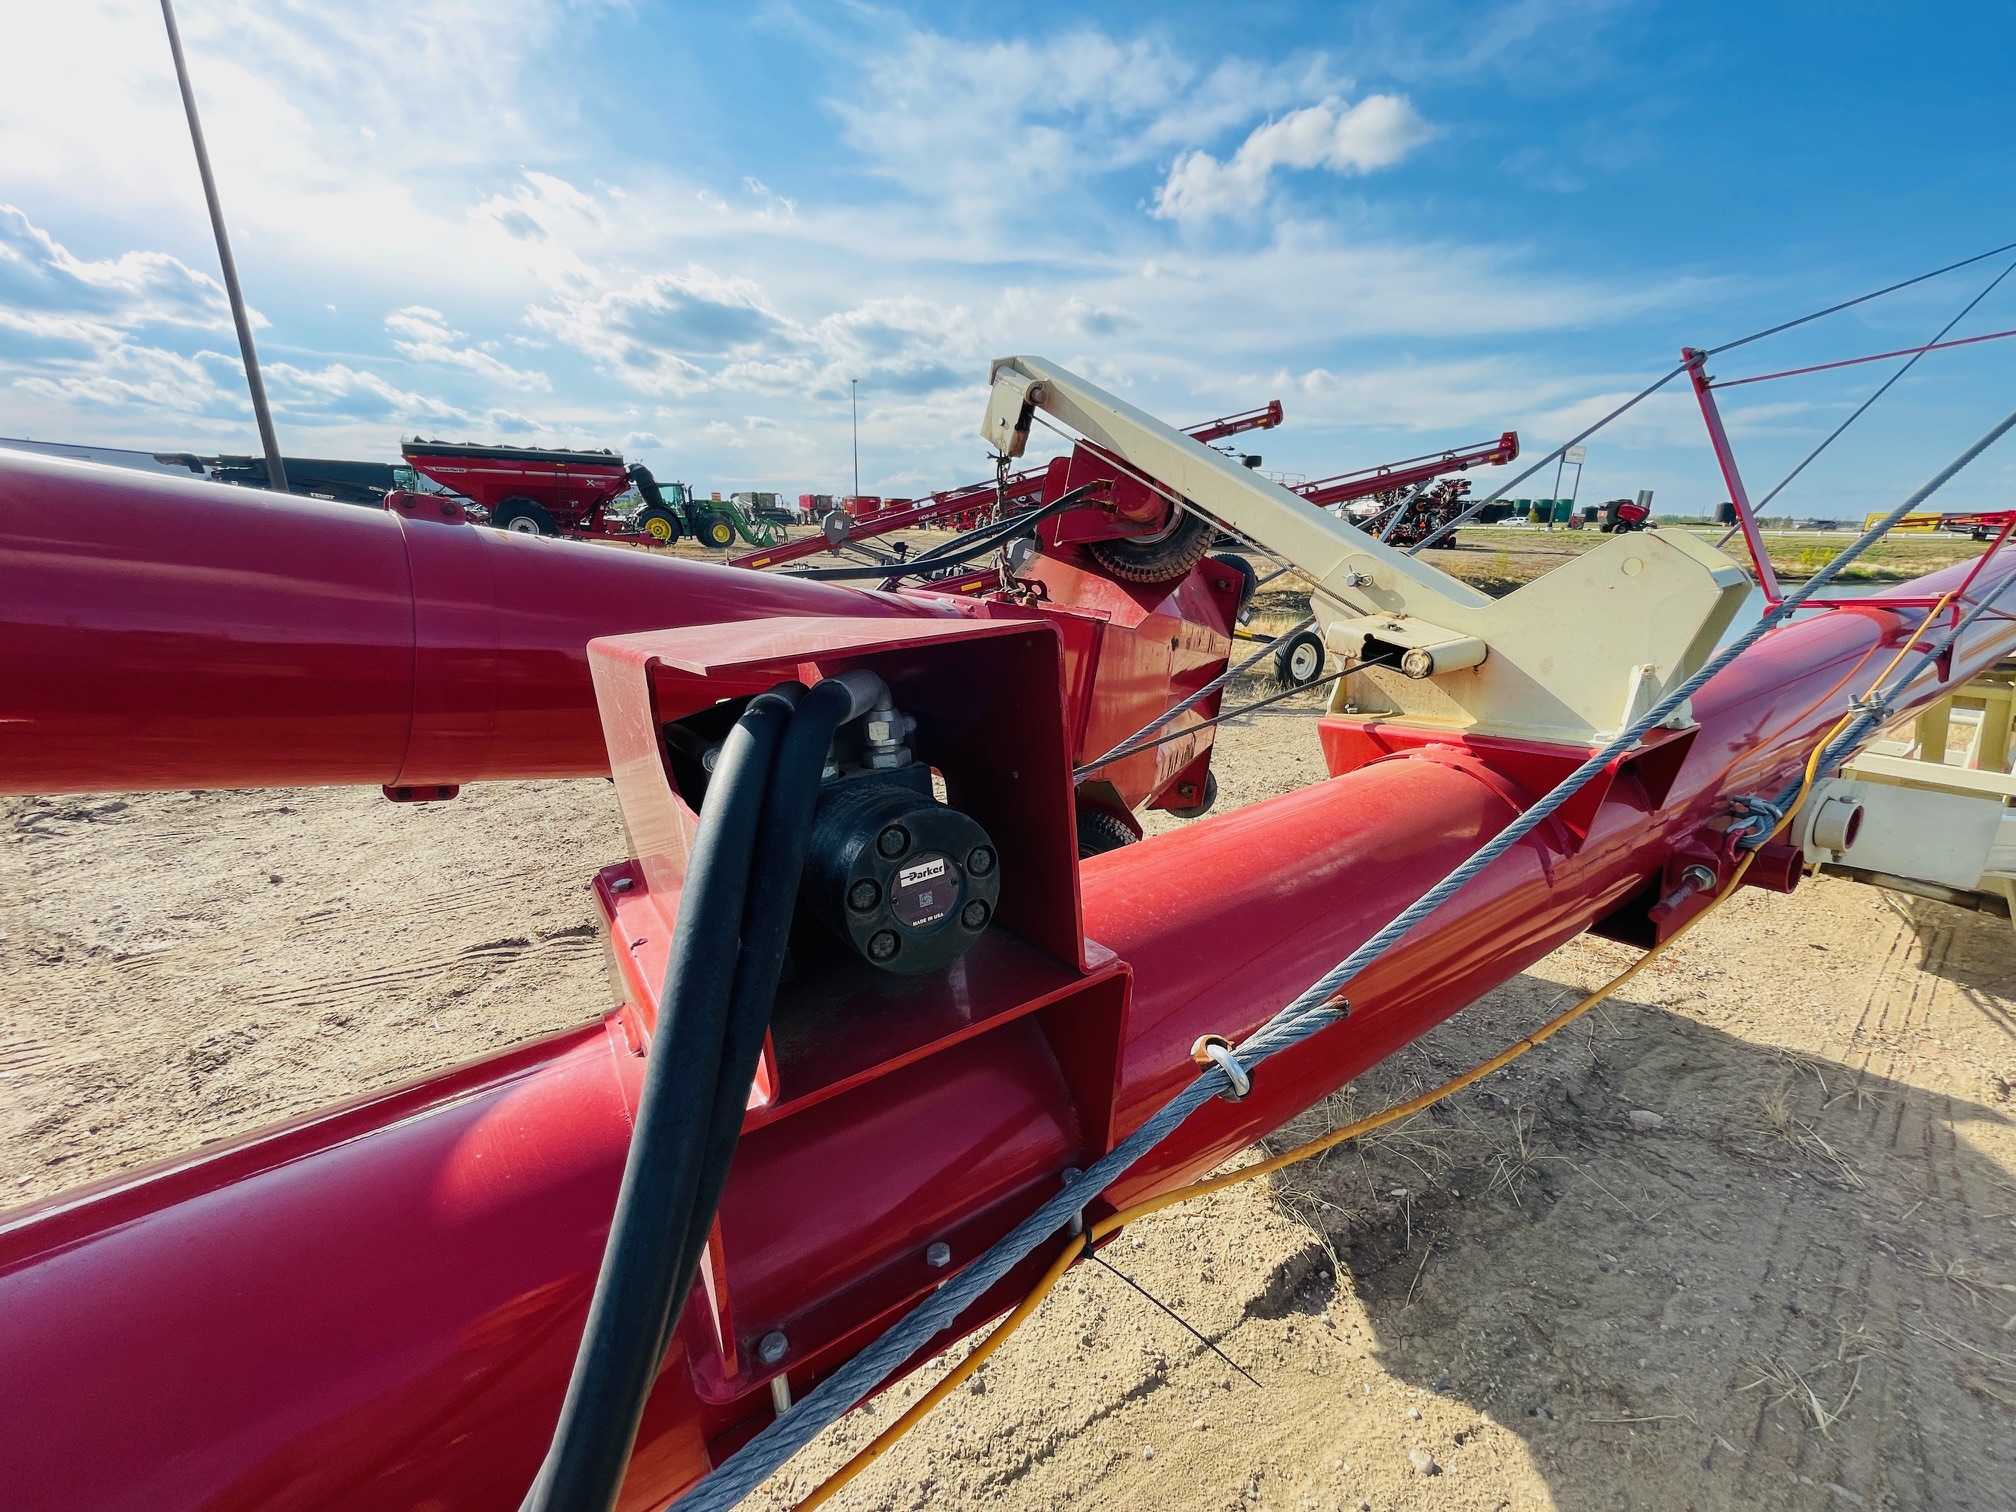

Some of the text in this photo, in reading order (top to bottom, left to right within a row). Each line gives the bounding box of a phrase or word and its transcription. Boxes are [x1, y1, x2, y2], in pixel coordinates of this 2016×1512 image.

[310, 492, 335, 500] FENDT
[905, 864, 944, 882] Parker
[912, 917, 927, 927] MADE
[933, 912, 944, 920] USA
